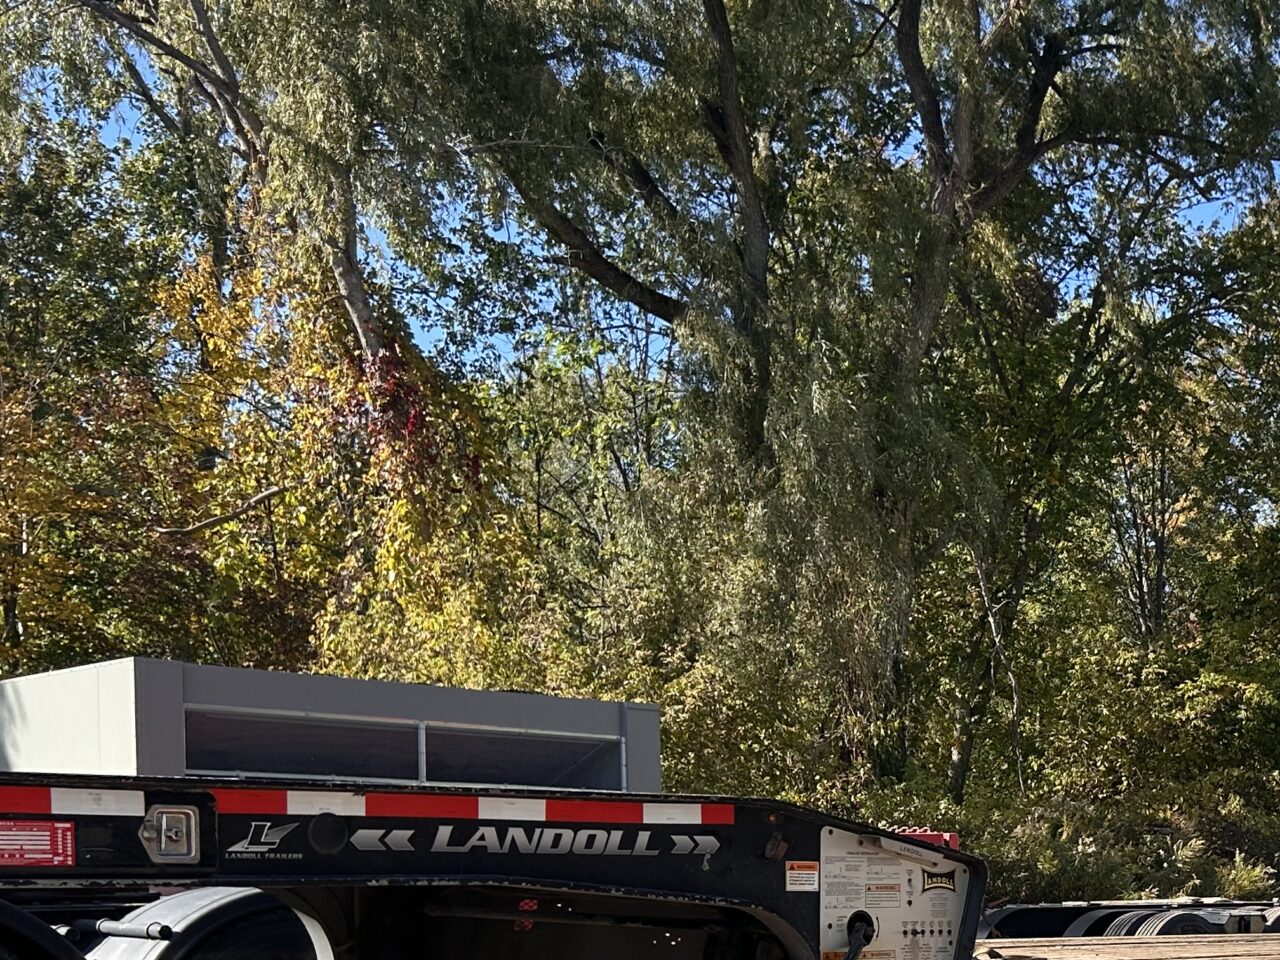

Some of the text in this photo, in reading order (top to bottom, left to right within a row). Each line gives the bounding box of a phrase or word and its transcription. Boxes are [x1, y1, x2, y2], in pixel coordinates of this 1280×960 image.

[429, 824, 661, 857] LANDOLL
[224, 852, 262, 860] LANDOLL
[923, 872, 955, 890] LANDOLL
